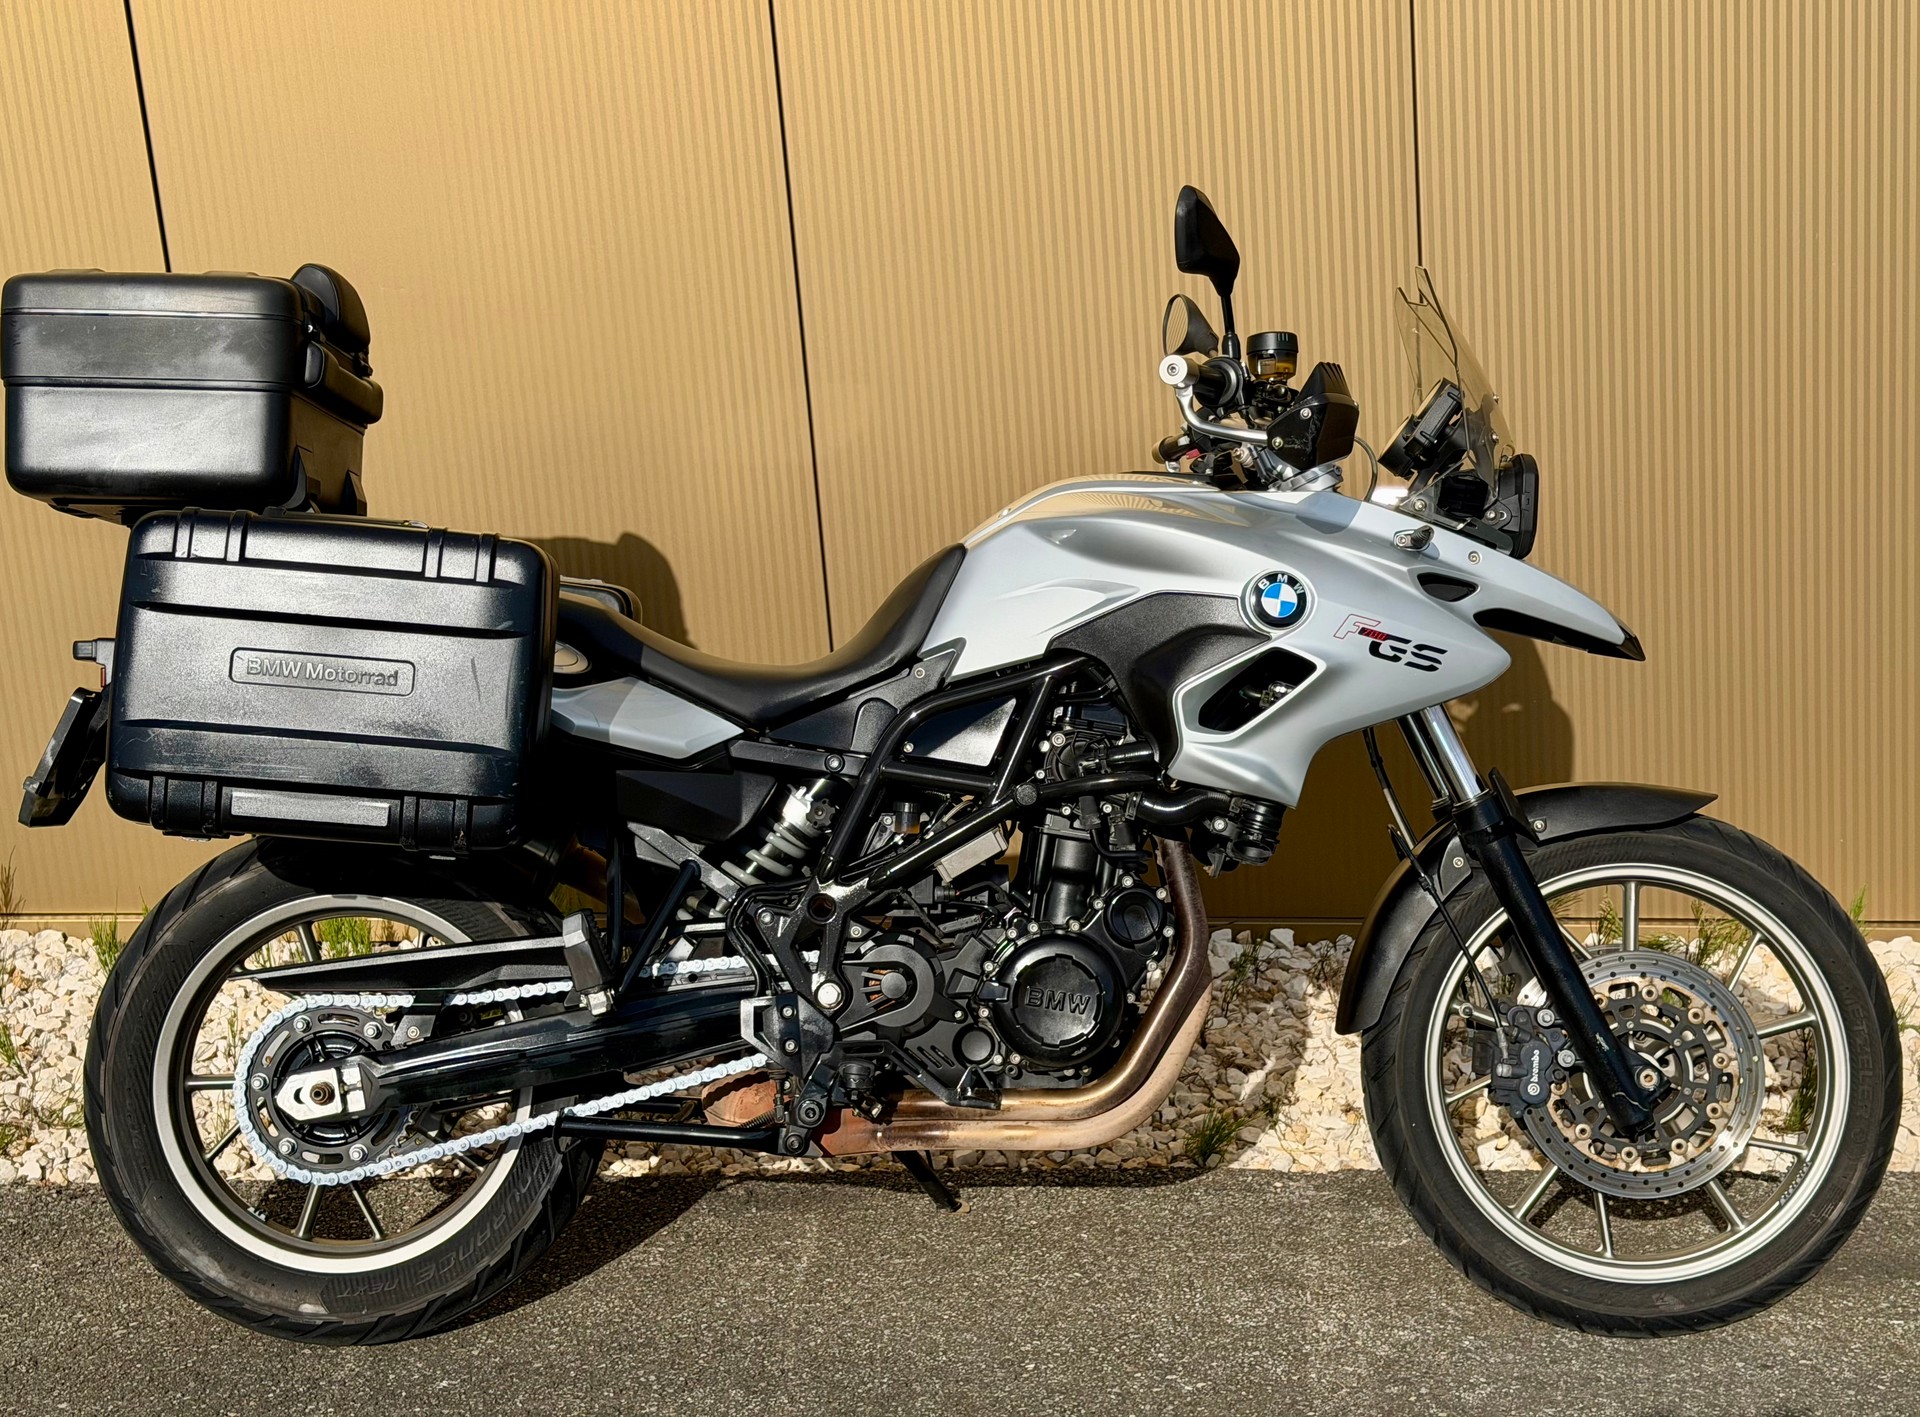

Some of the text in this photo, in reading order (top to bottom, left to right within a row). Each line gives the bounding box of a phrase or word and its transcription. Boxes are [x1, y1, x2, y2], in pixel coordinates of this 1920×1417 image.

[1258, 573, 1305, 595] BMW
[1333, 614, 1448, 672] F 700 GS
[247, 657, 399, 687] BMW Motorrad
[1025, 986, 1091, 1015] BMW
[1530, 1049, 1540, 1082] brembo
